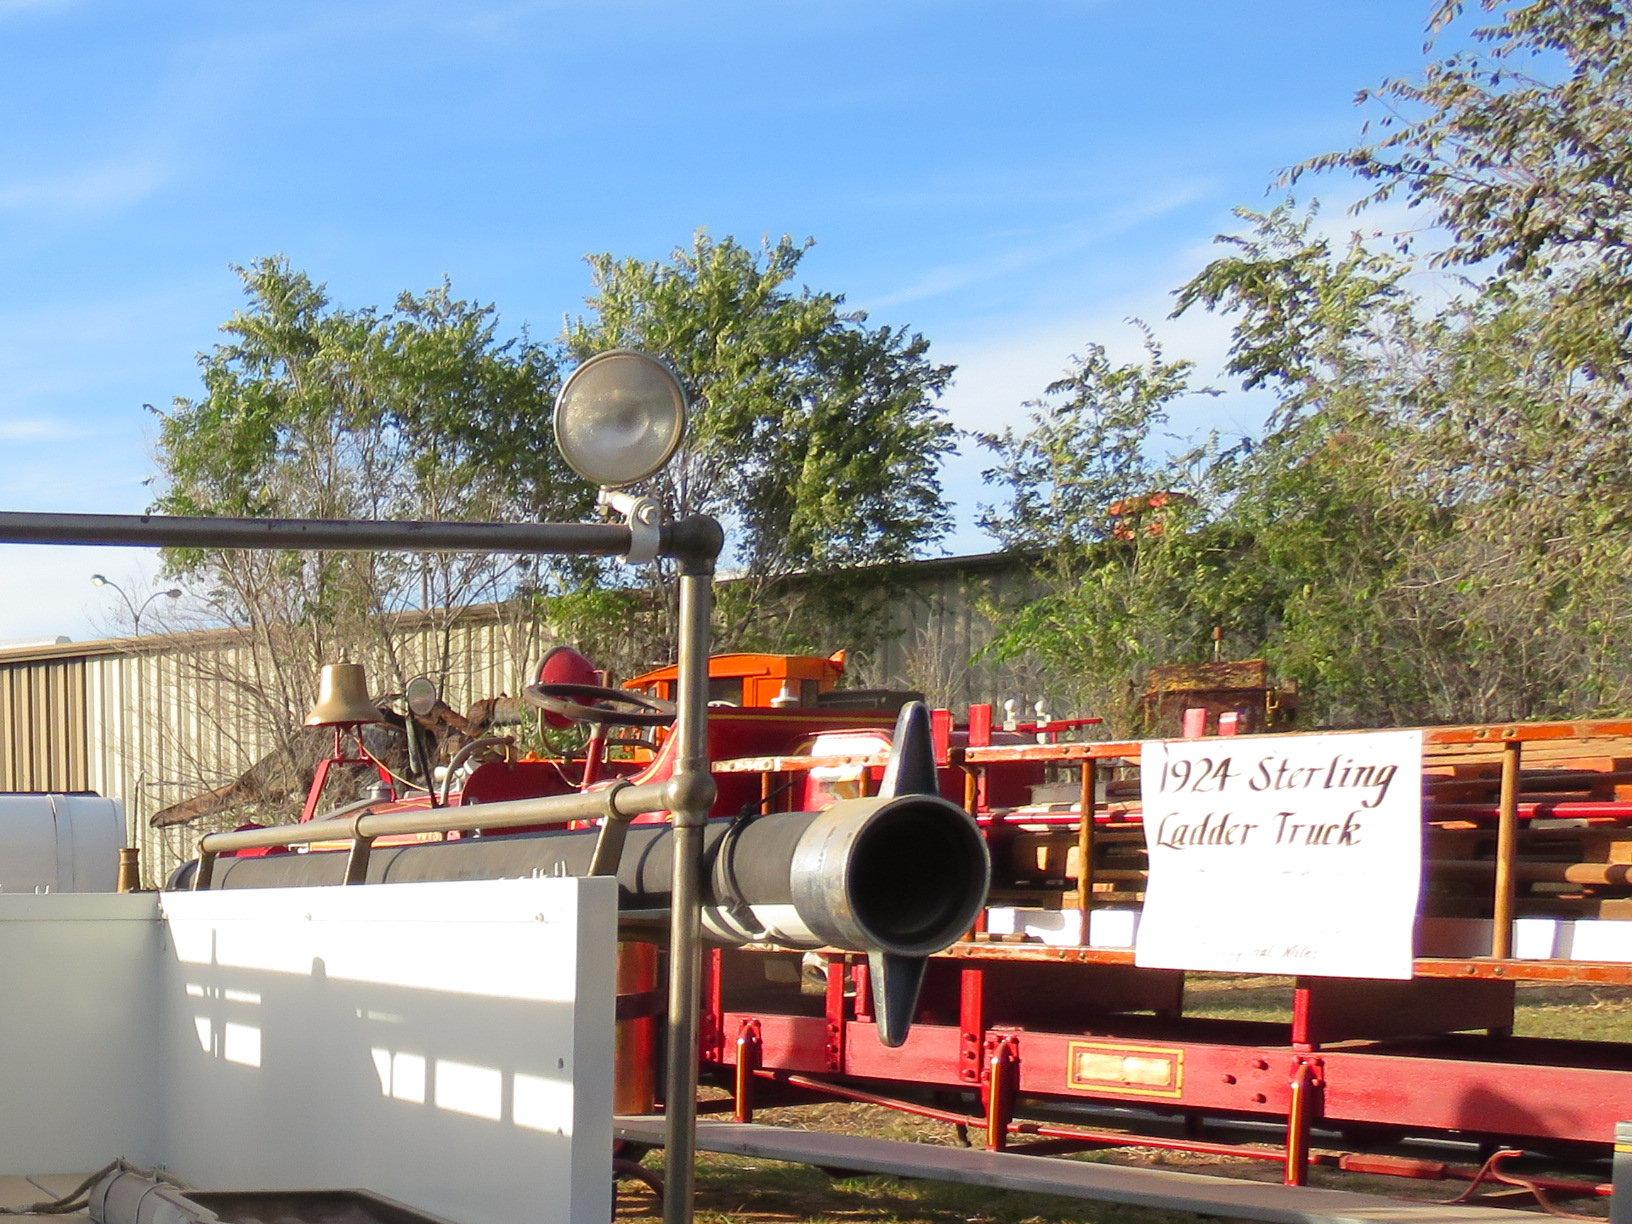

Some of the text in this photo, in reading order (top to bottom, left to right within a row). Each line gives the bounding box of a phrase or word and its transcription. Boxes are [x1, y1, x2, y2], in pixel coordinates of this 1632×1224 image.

[1159, 753, 1400, 809] 1924 Sterling
[1155, 810, 1363, 851] Ladder Truck
